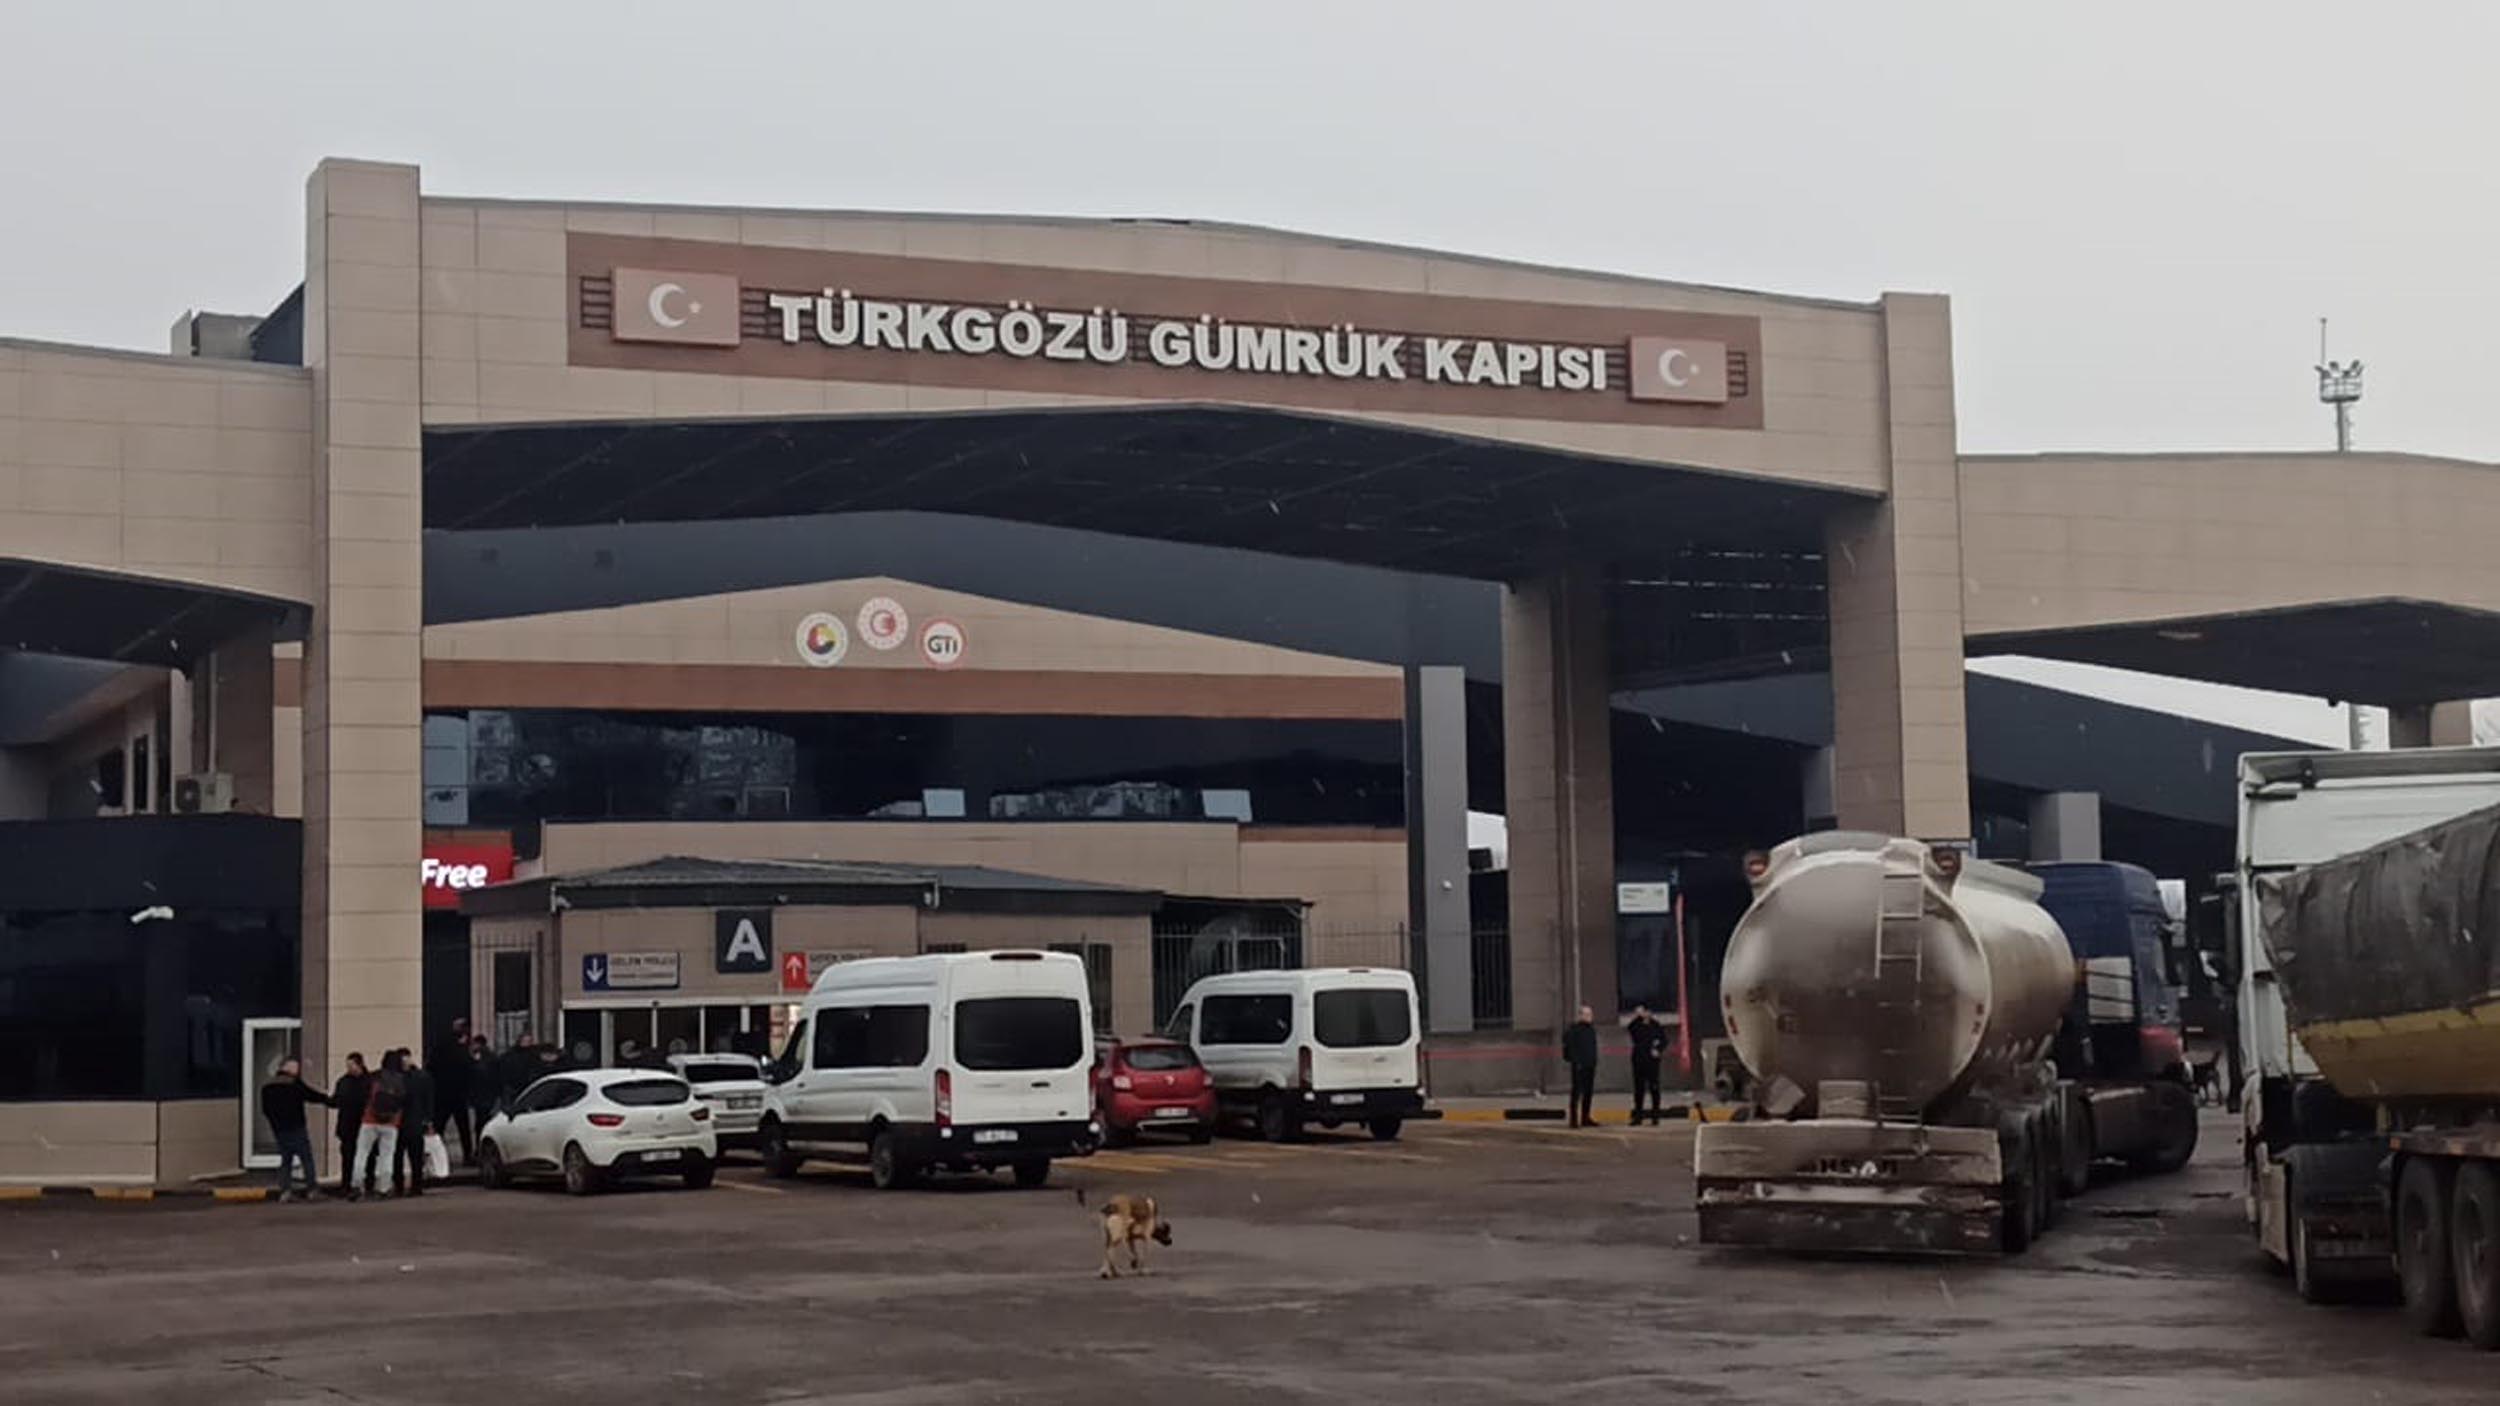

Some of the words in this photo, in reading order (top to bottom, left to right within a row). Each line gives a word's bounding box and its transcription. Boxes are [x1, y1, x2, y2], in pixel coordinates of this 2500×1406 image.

[769, 288, 1129, 362] TÜRKGÖZÜ
[1149, 314, 1404, 378] GÜMRÜK
[1425, 338, 1607, 390] KAPISI
[422, 858, 487, 889] Free
[726, 918, 766, 961] A
